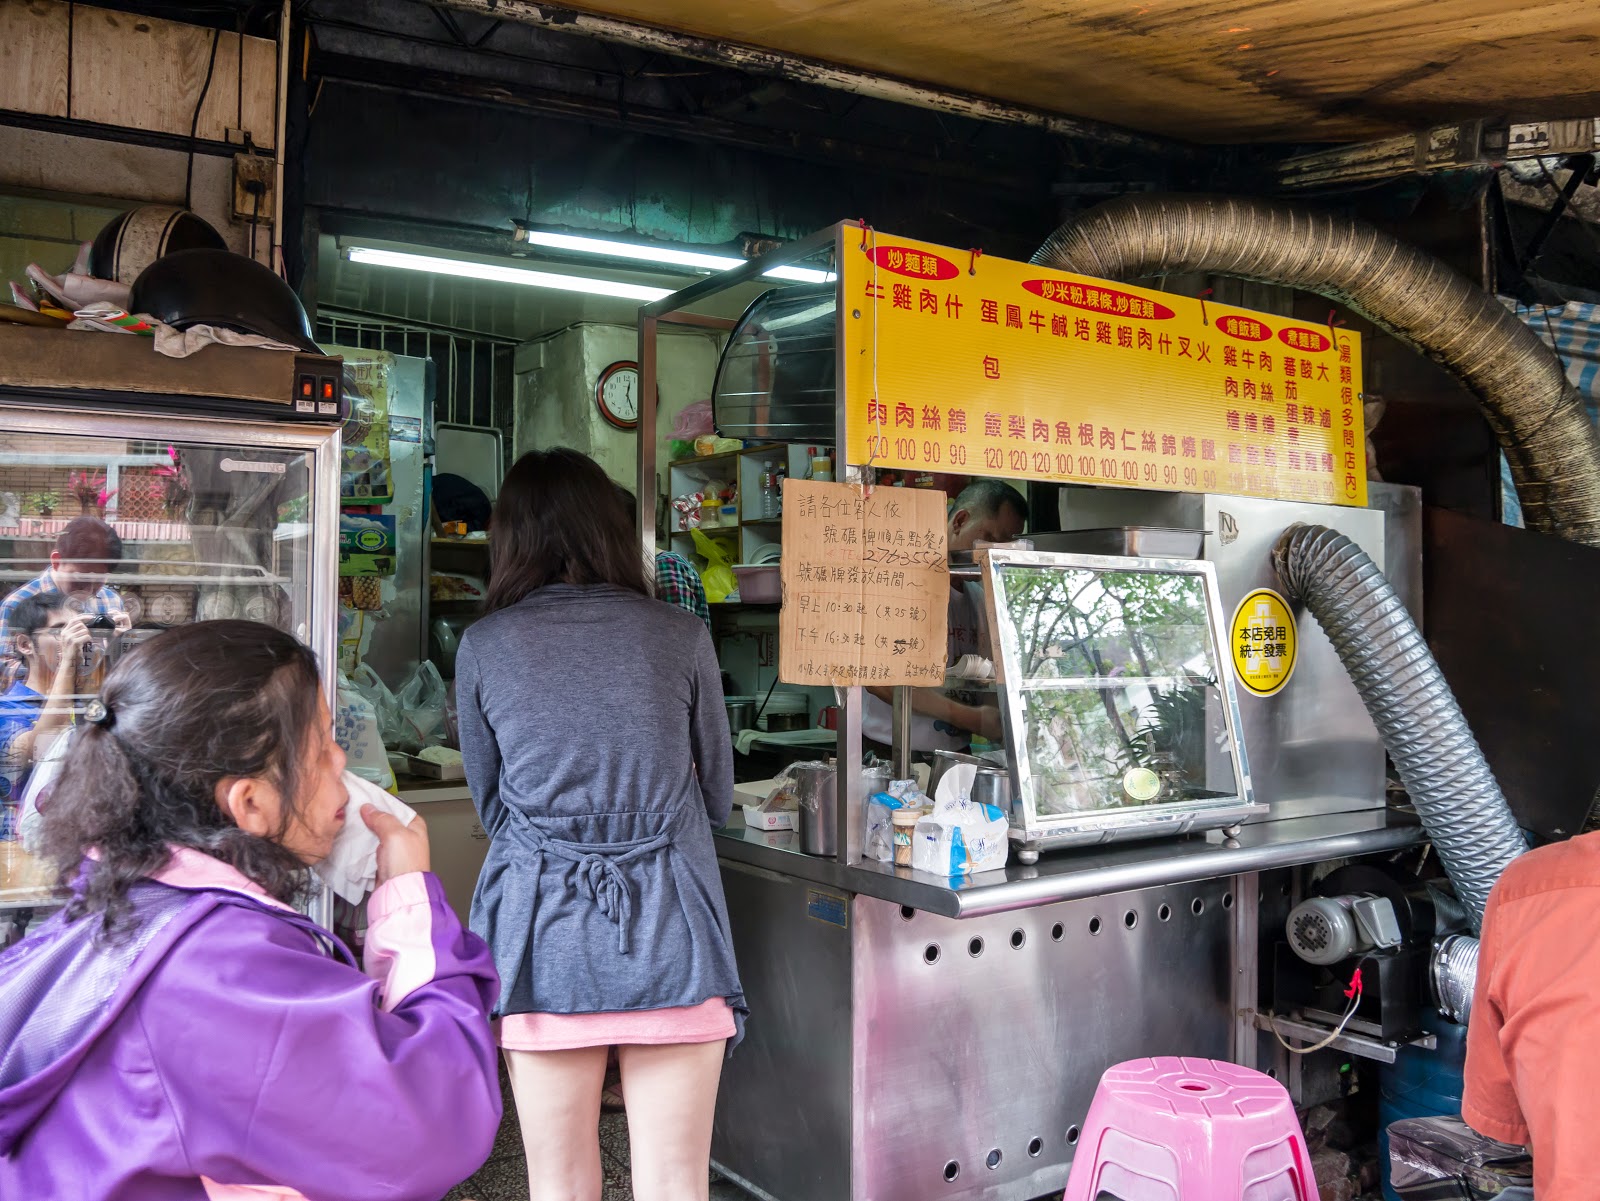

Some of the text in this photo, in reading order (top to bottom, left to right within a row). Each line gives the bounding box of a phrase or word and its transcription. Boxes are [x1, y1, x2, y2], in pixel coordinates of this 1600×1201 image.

[888, 249, 938, 277] 炒麵類
[895, 438, 916, 461] 100
[923, 440, 941, 463] 90
[949, 444, 966, 466] 90
[984, 447, 1003, 469] 120
[1008, 450, 1028, 472] 120
[1032, 452, 1051, 473] 120
[1055, 453, 1073, 475] 100
[1078, 456, 1096, 477] 100
[1100, 458, 1117, 479] 100
[1121, 460, 1138, 481] 100
[1144, 463, 1157, 483] 90
[1163, 465, 1177, 485] 90
[1184, 466, 1197, 487] 90
[1239, 627, 1287, 641] 本店免用
[1239, 644, 1287, 658] 統一發票
